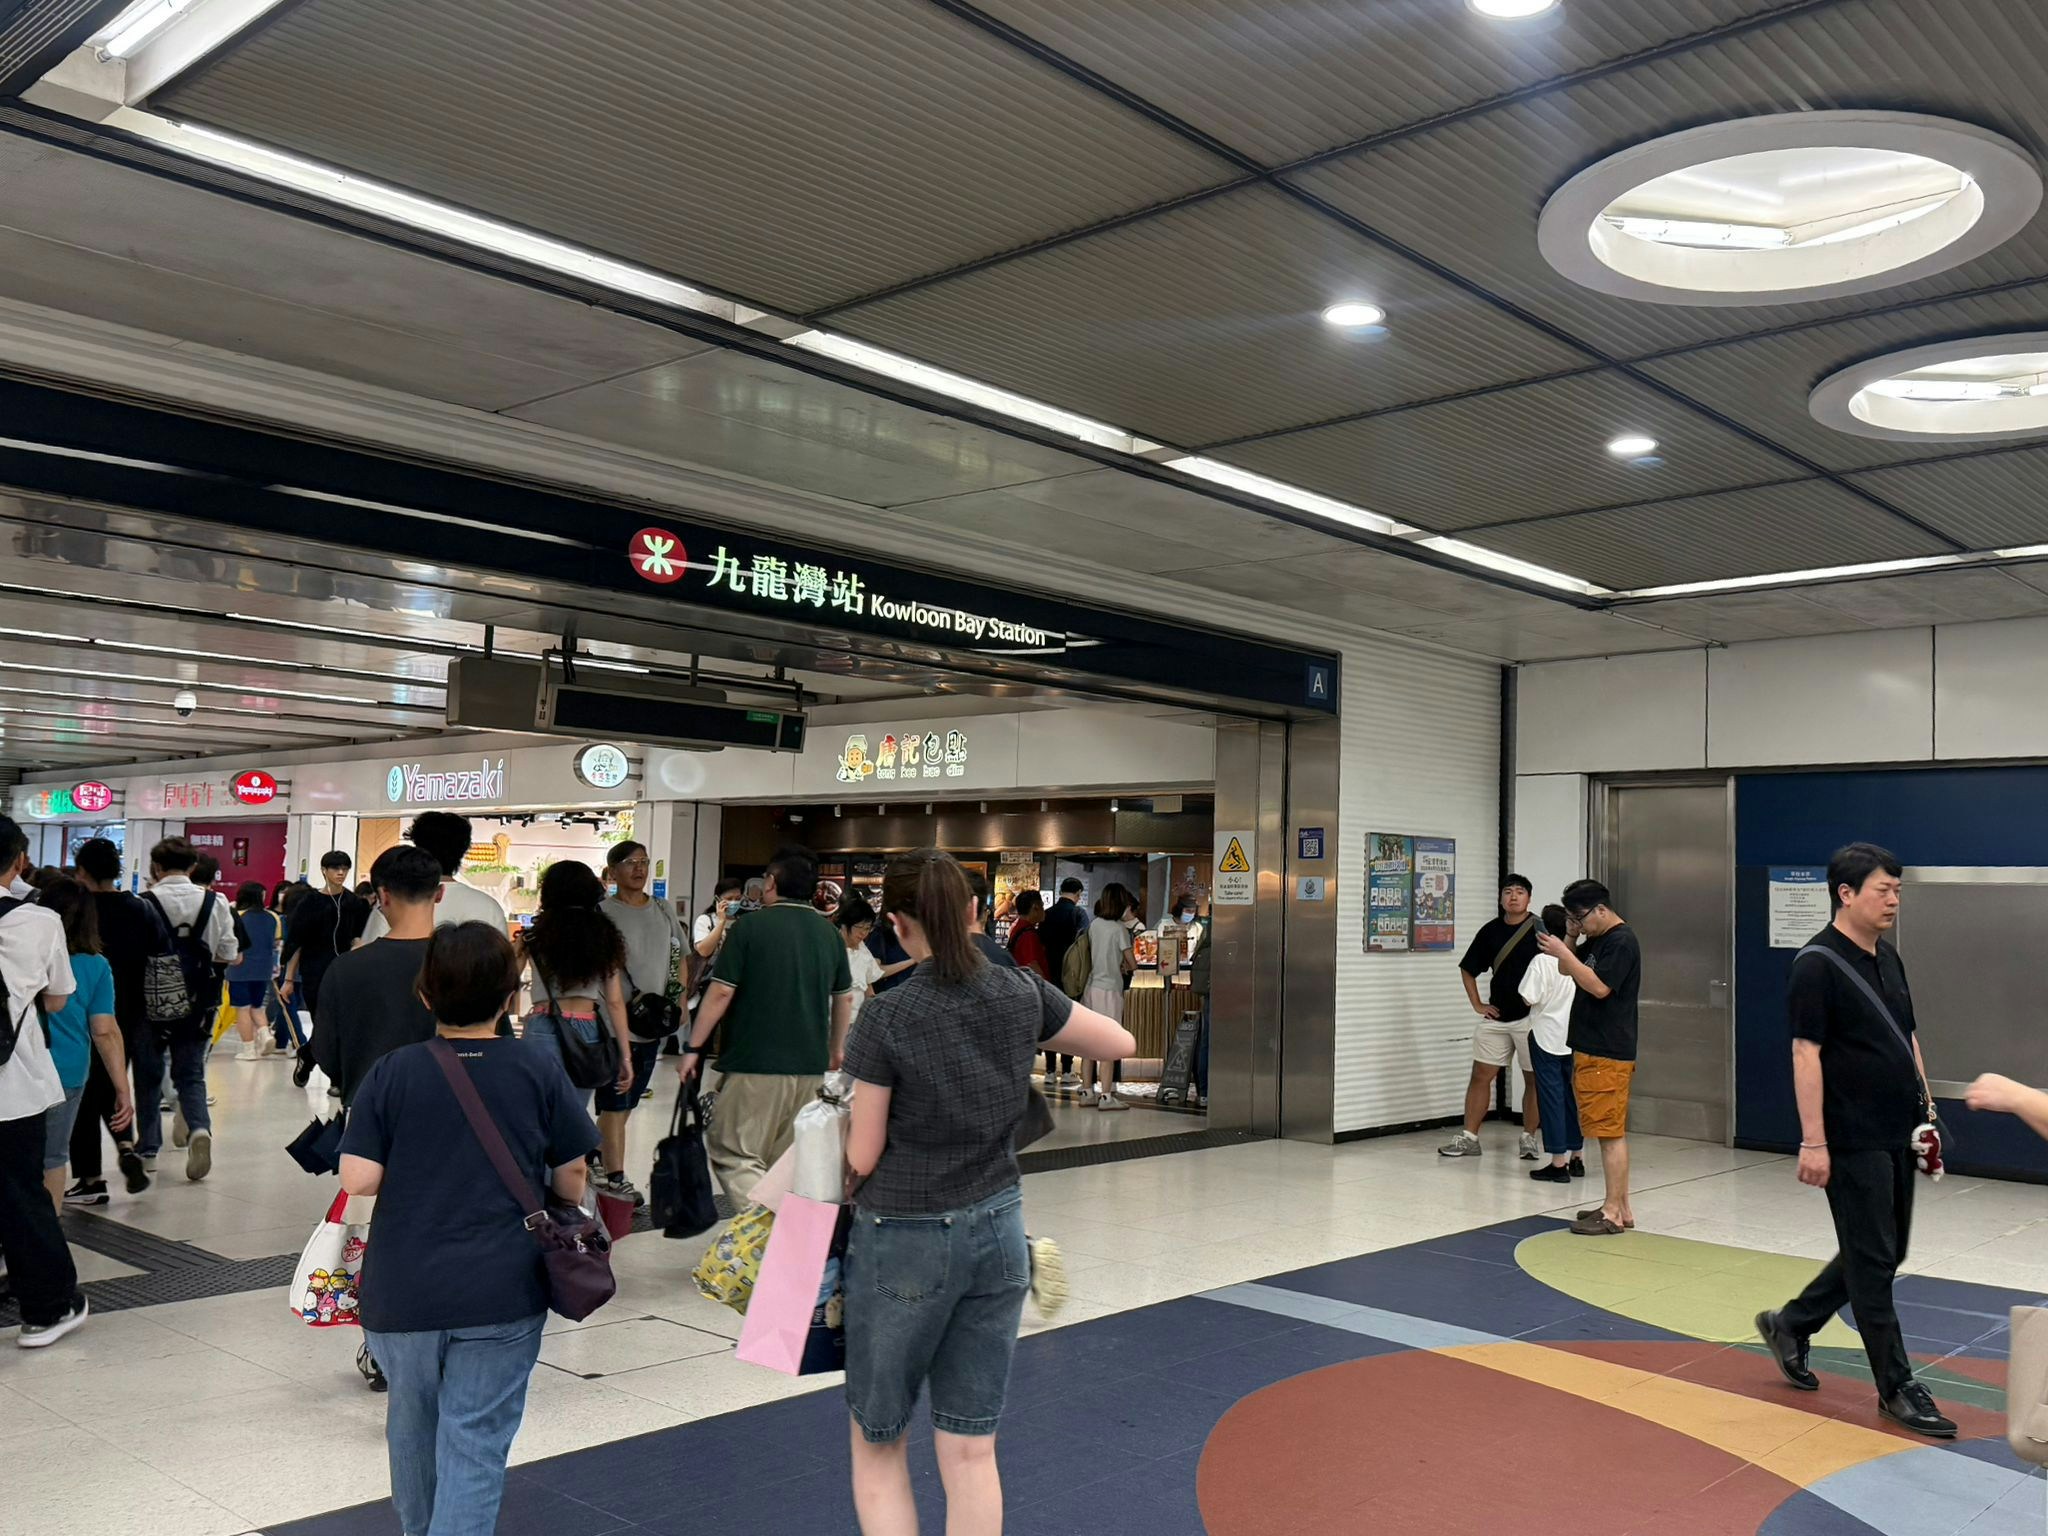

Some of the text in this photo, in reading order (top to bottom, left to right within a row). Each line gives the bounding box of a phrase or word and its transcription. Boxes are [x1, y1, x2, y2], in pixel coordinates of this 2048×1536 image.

[706, 546, 865, 615] 九龍灣站
[871, 594, 1046, 646] Kowloon Bay Station
[1313, 672, 1324, 694] A
[876, 729, 967, 767] 唐記包點
[403, 759, 503, 801] Yamazaki
